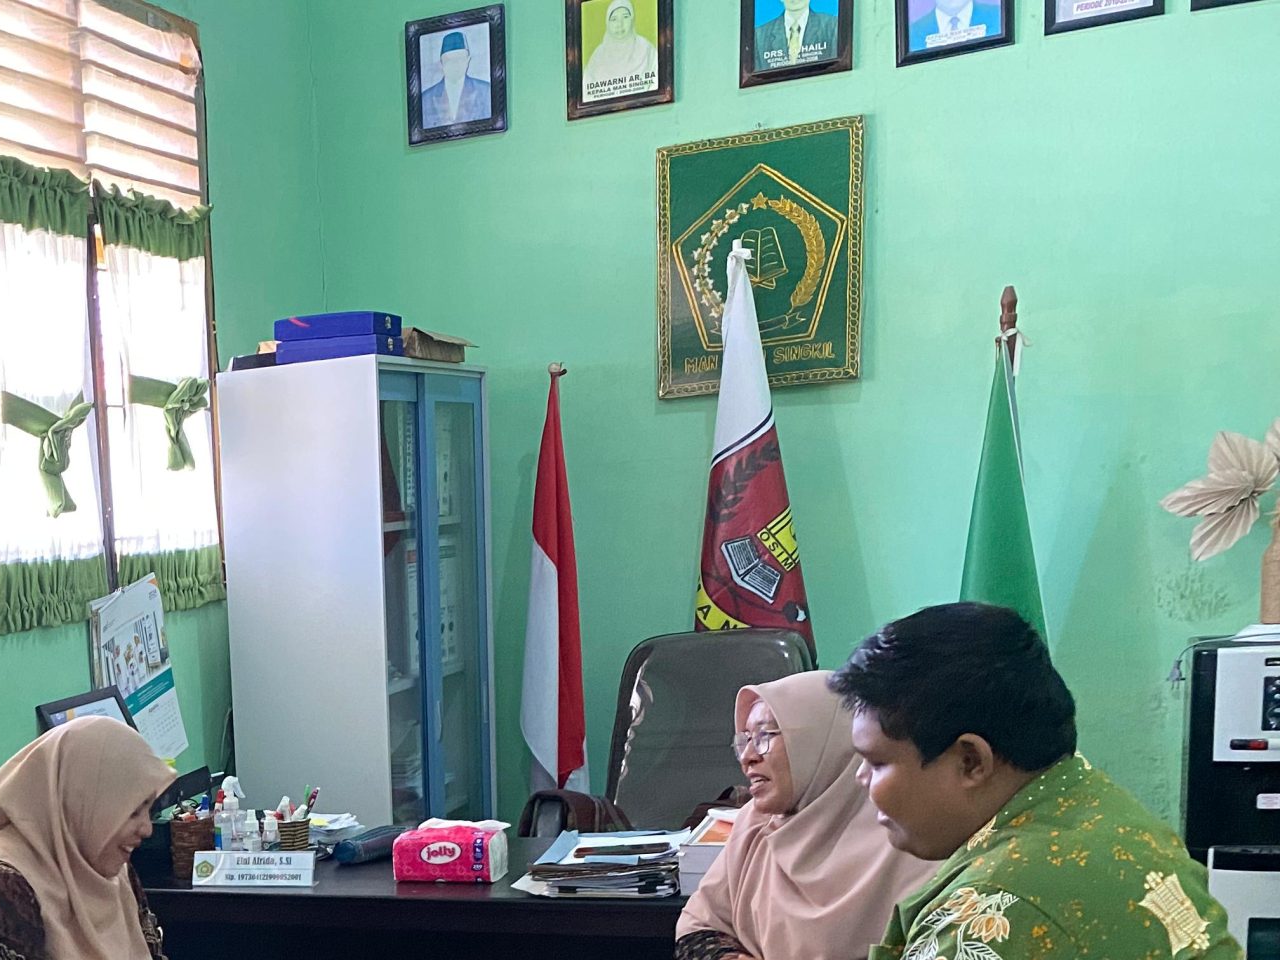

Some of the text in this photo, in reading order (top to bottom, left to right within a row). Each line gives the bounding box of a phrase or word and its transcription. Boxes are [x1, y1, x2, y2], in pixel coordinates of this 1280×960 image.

[763, 49, 786, 59] DRS.
[586, 77, 627, 90] IDAWARNI
[644, 71, 656, 79] BA
[587, 79, 655, 96] KEPALA MAN SINGKIL
[684, 341, 835, 375] MAN SINGKIL
[426, 845, 456, 860] jolly
